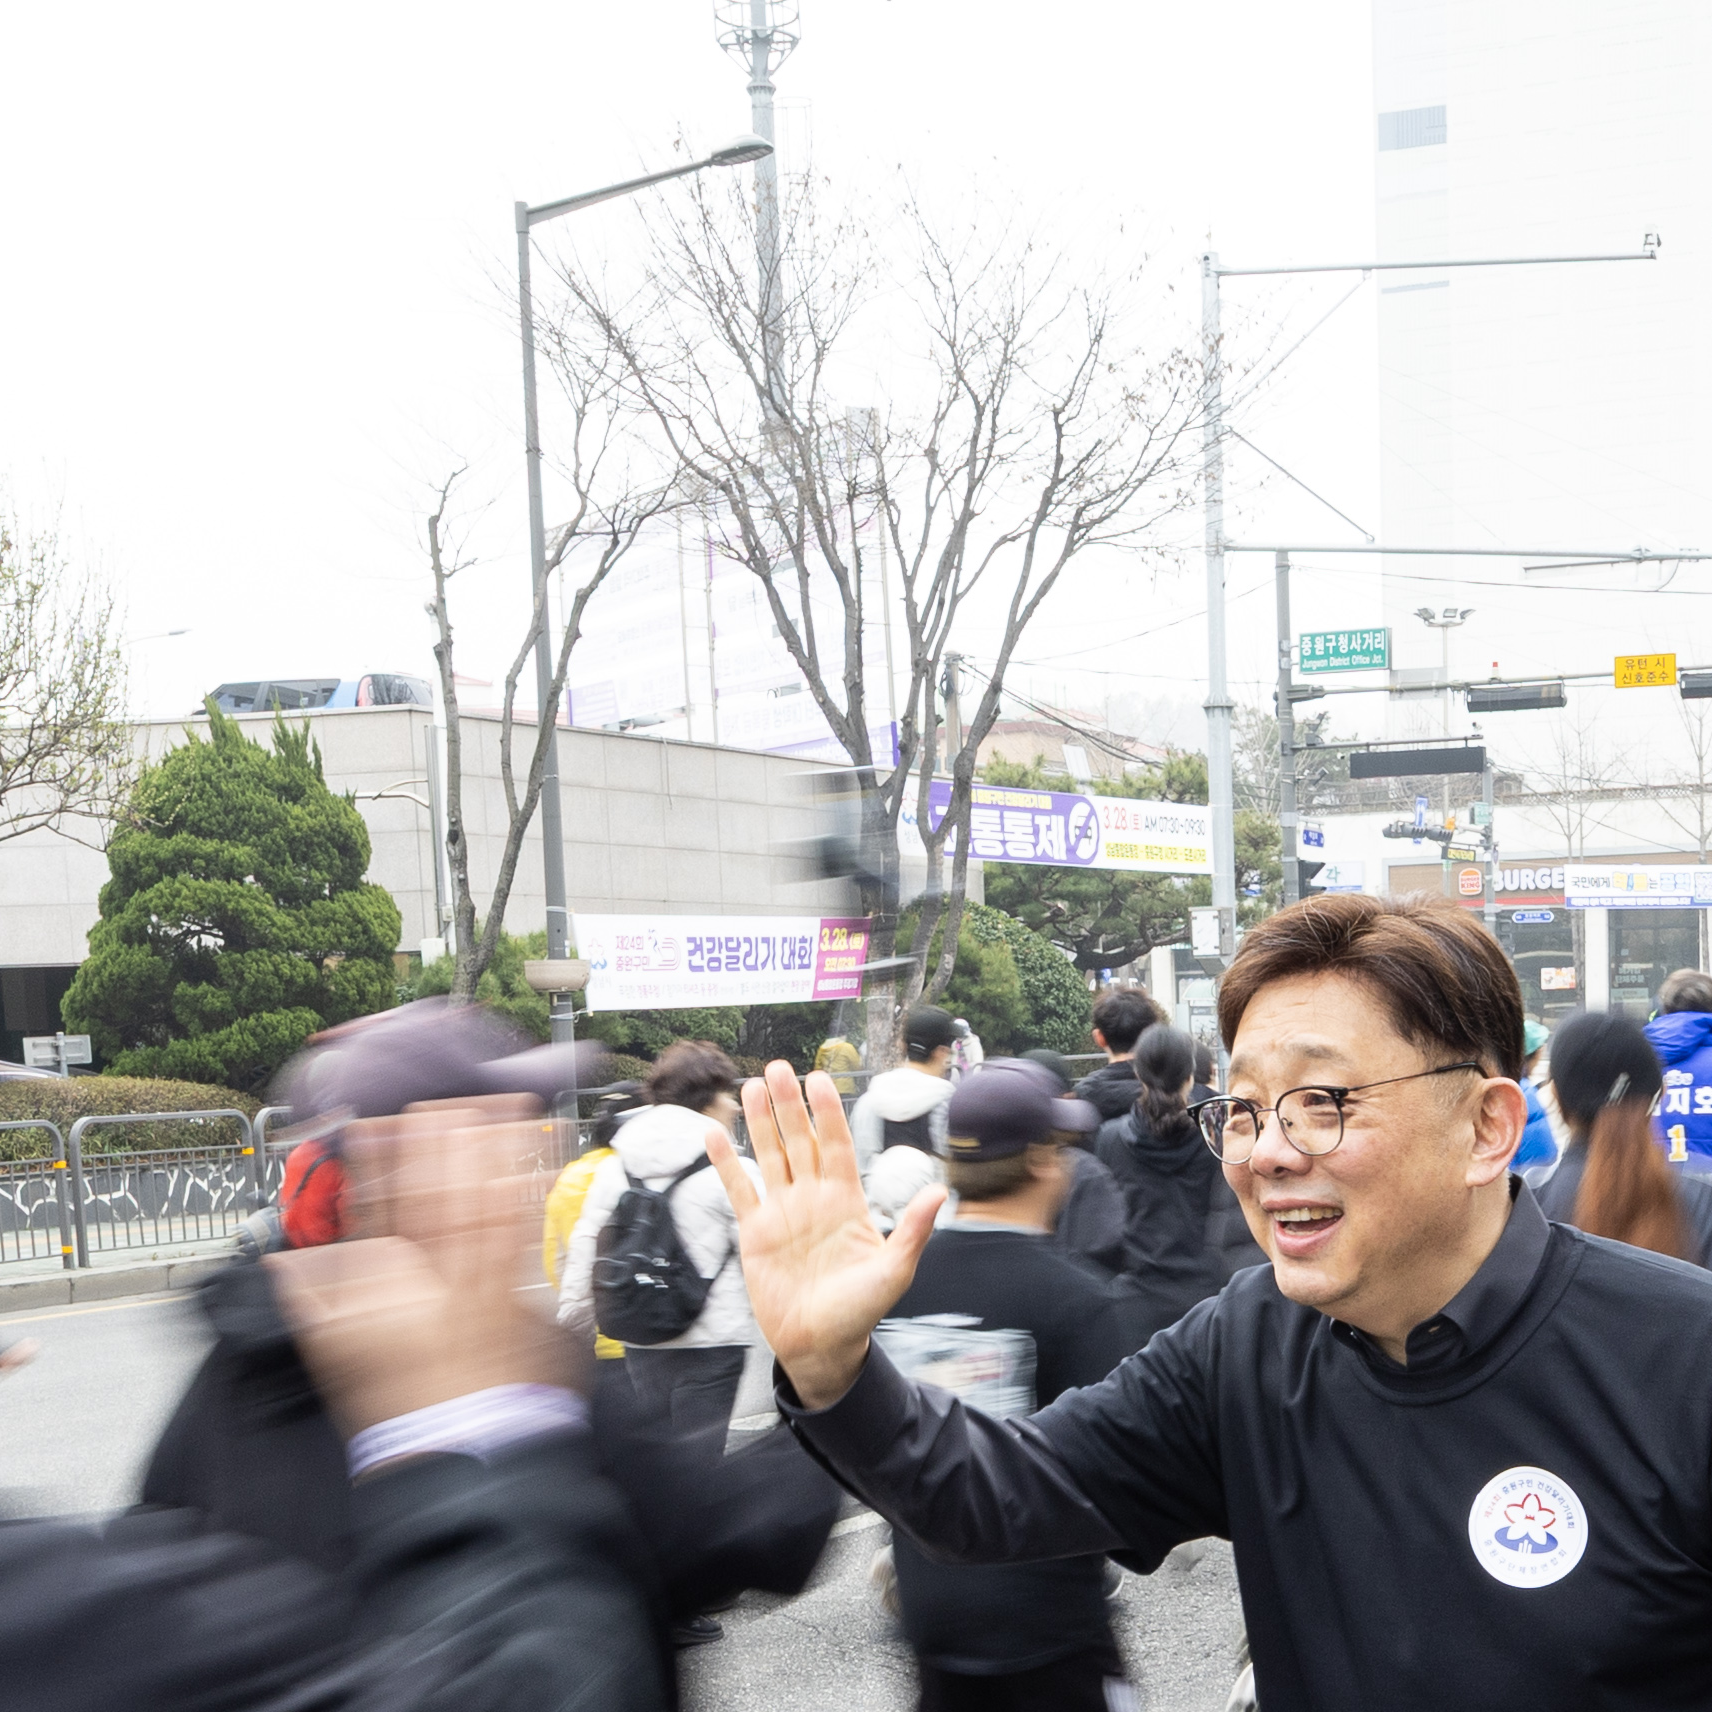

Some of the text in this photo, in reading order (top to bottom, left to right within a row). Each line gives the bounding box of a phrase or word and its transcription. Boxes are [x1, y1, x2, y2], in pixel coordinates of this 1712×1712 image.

[1301, 630, 1385, 656] 중원구청사거리
[1622, 670, 1669, 684] 신호준수
[1625, 657, 1666, 671] 유턴 시
[935, 803, 1068, 861] 통통제
[1460, 881, 1481, 890] KING
[686, 935, 814, 973] 건강달리기 대회
[1667, 1124, 1689, 1162] 1
